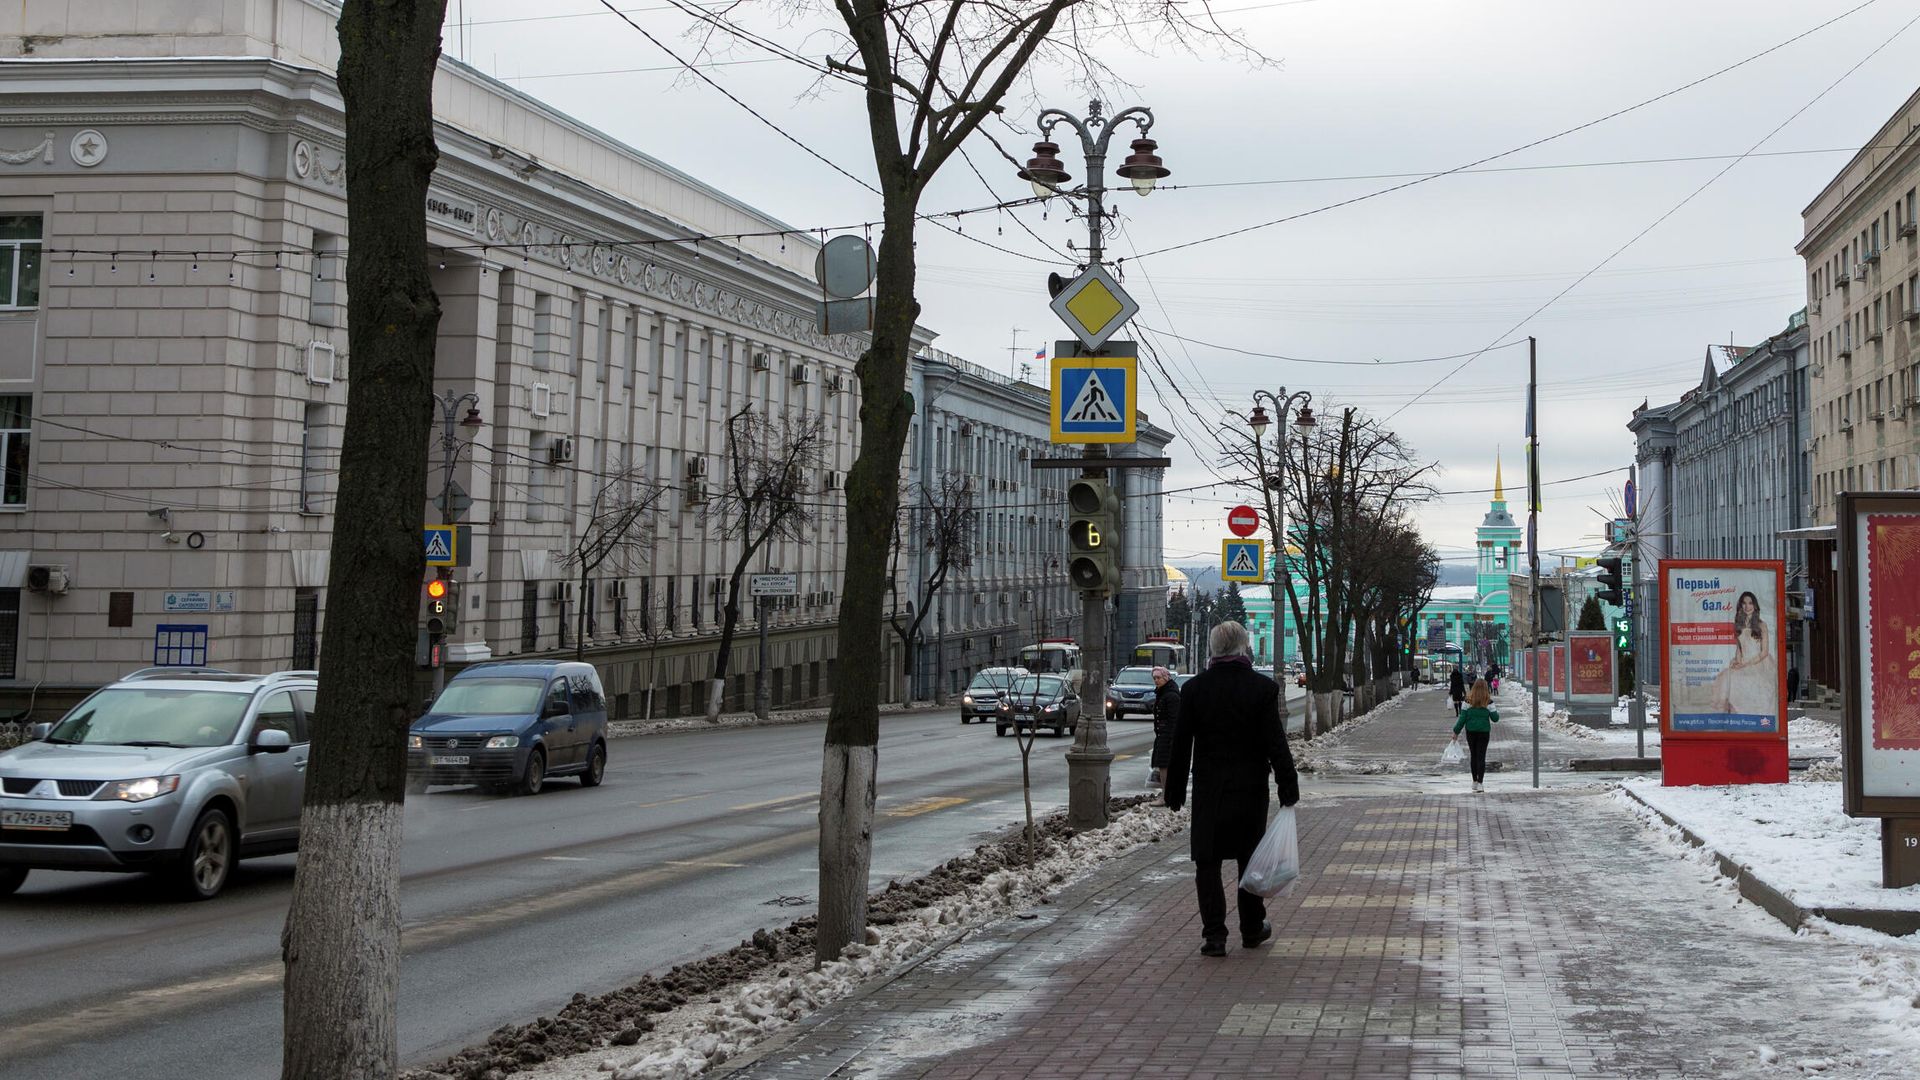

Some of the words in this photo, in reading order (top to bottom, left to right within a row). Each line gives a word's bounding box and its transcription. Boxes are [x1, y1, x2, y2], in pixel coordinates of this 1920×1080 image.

[1088, 523, 1100, 546] 6
[1677, 577, 1720, 591] Первый
[435, 600, 443, 613] 6
[1616, 620, 1629, 632] 46
[1579, 670, 1605, 678] 2020
[1904, 837, 1918, 847] 19
